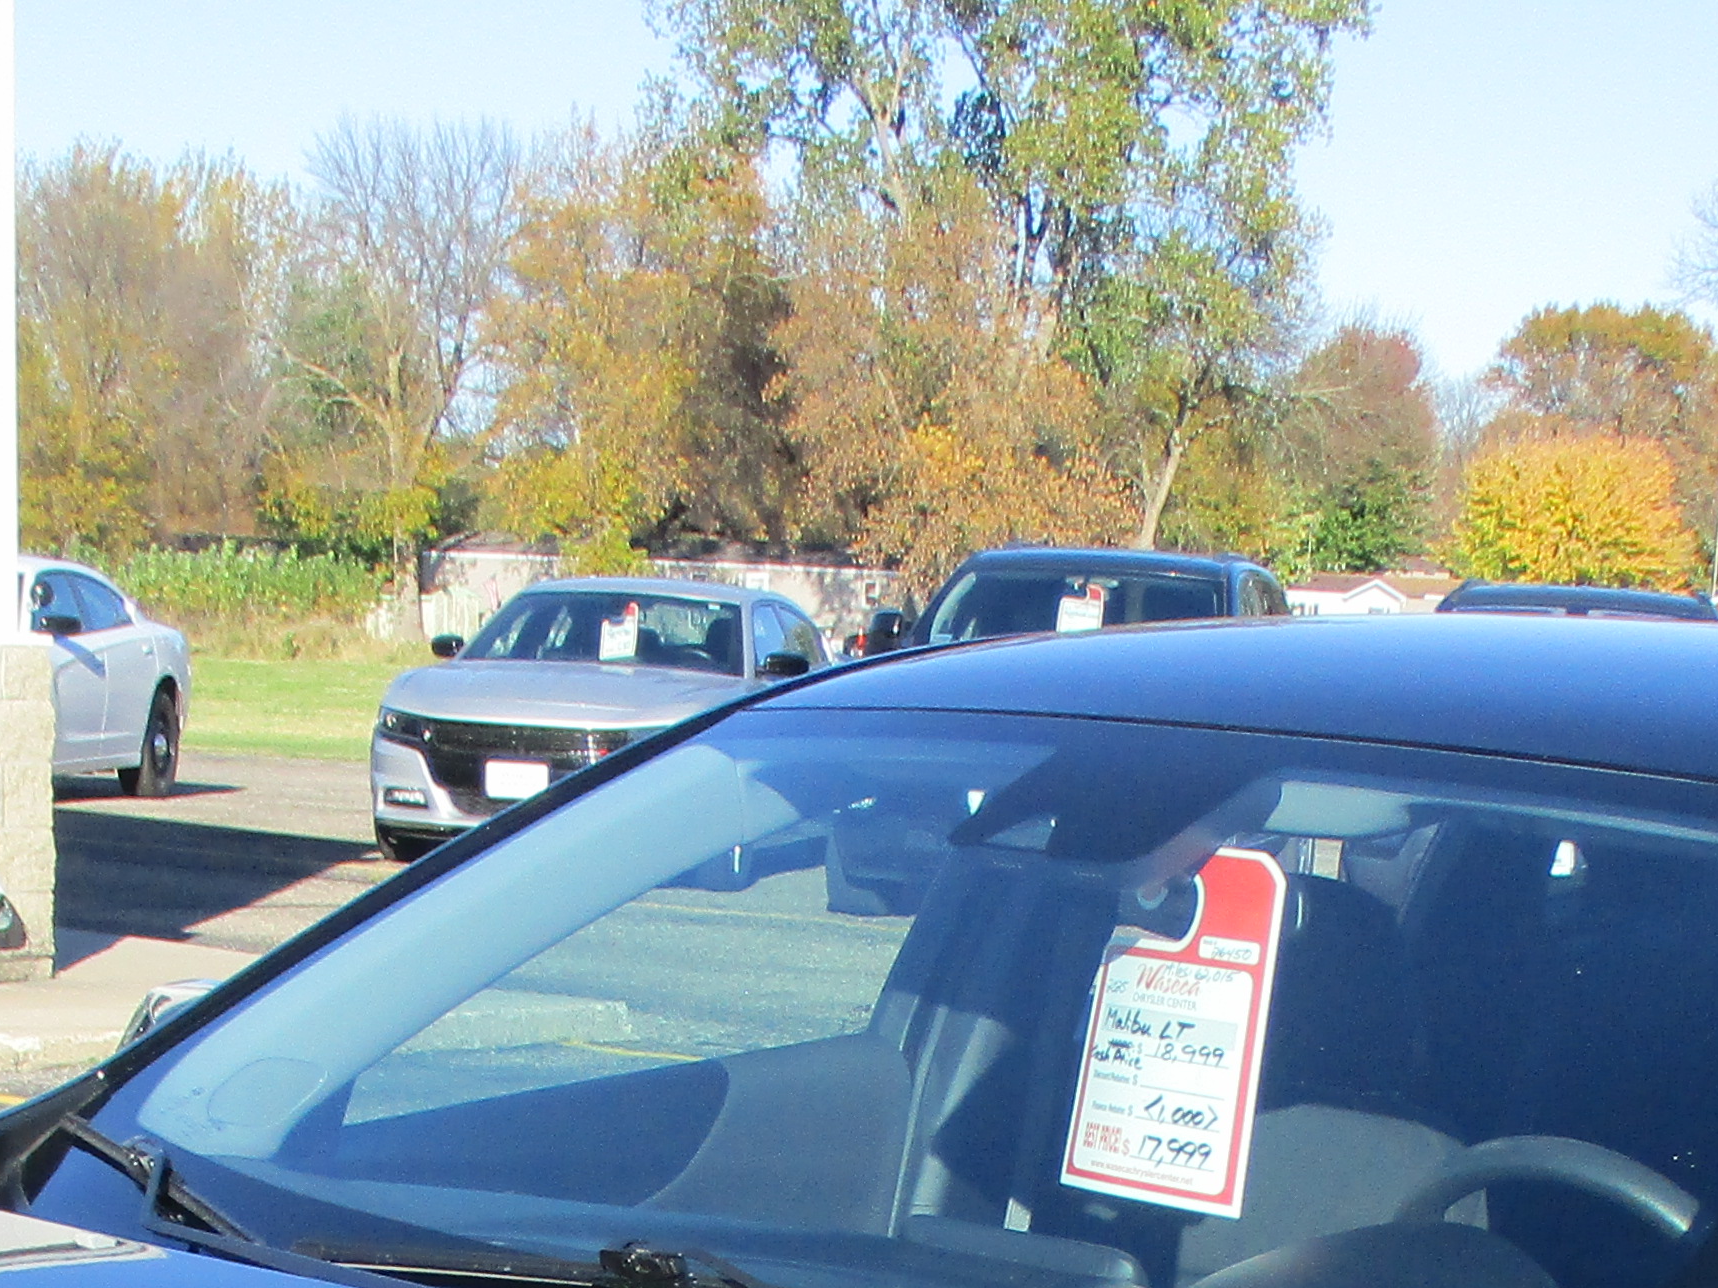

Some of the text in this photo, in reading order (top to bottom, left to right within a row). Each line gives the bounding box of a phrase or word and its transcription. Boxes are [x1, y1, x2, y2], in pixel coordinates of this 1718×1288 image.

[1136, 963, 1201, 996] Waseca
[1167, 998, 1196, 1011] CENTER
[1104, 1006, 1196, 1040] Malibu LT
[1155, 1042, 1224, 1067] 18,999
[1138, 1135, 1212, 1168] 17,999
